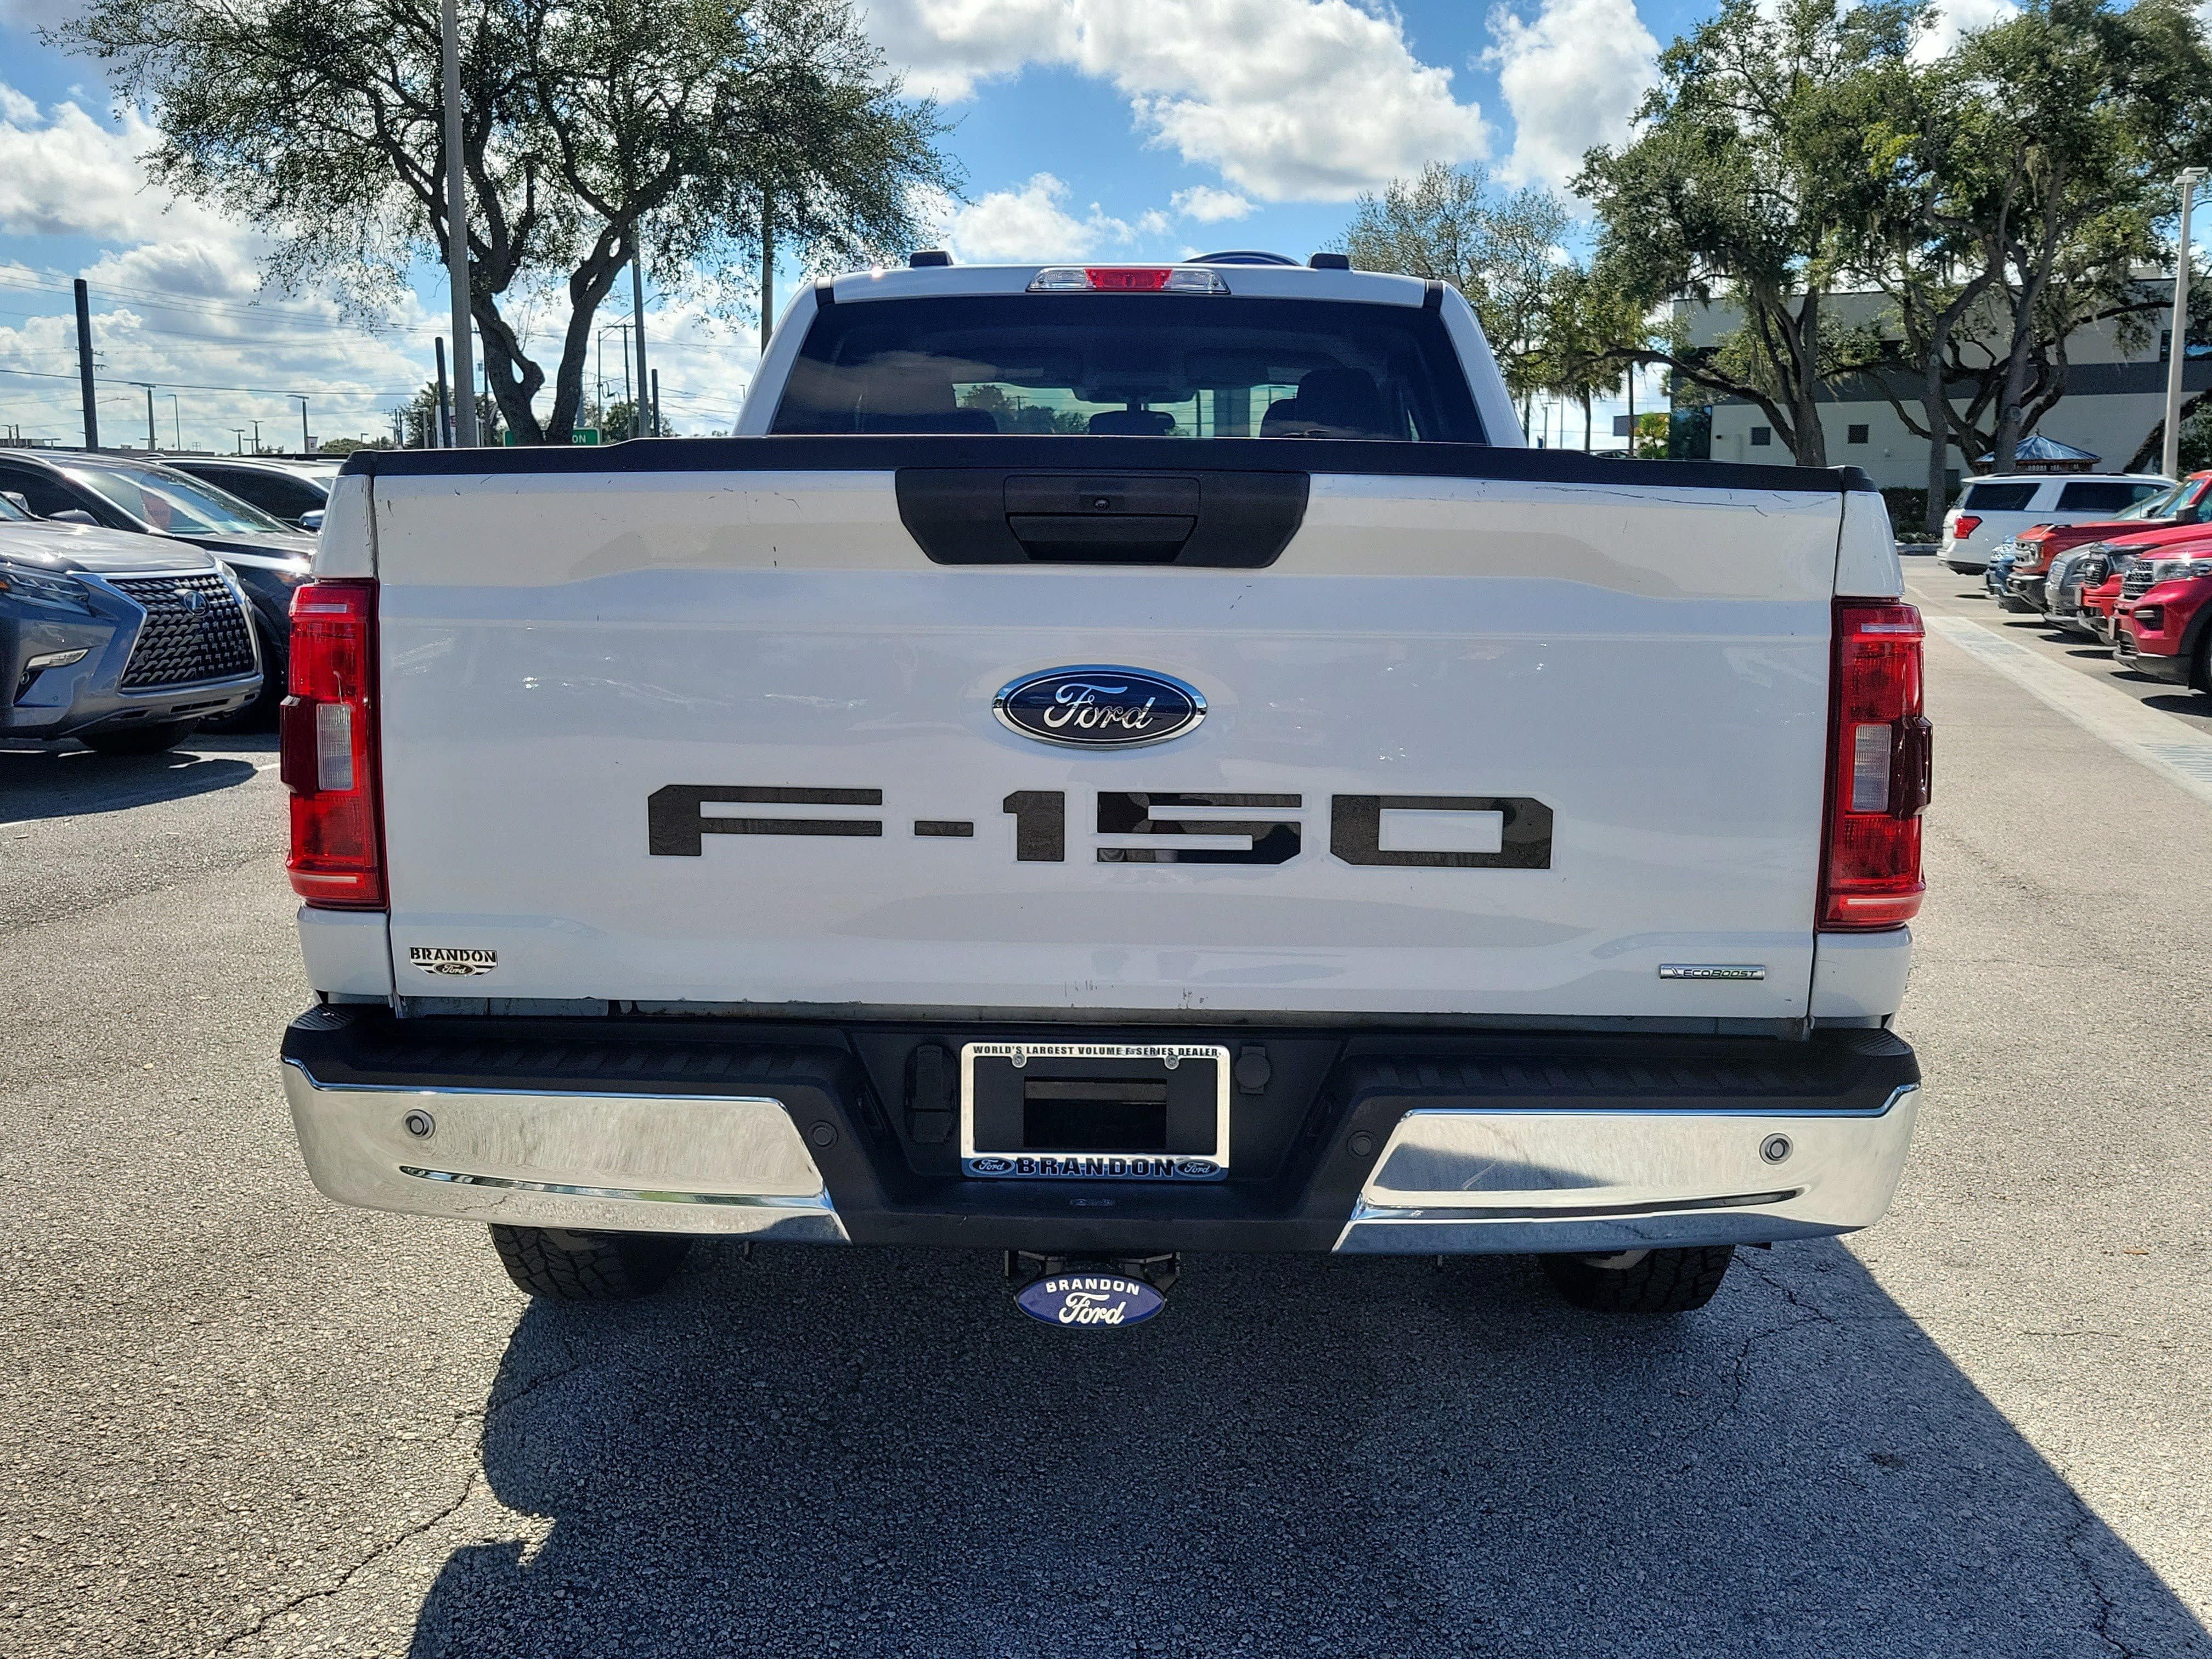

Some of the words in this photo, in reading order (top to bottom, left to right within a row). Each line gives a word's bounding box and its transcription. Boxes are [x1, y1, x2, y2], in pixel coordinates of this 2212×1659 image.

[1043, 683, 1155, 730] Ford
[648, 785, 1554, 869] F-150
[410, 947, 496, 962] BRANDON
[441, 964, 467, 974] Ford
[973, 1046, 1022, 1054] WORLD'S
[1026, 1046, 1074, 1054] LARGEST
[1078, 1047, 1122, 1056] VOLUME
[1178, 1048, 1217, 1056] DEALER
[979, 1159, 1005, 1171] Ford
[1017, 1157, 1174, 1177] BRANDON
[1183, 1162, 1211, 1174] Ford
[1046, 1278, 1140, 1296] BRANDON
[1059, 1292, 1126, 1324] Ford
